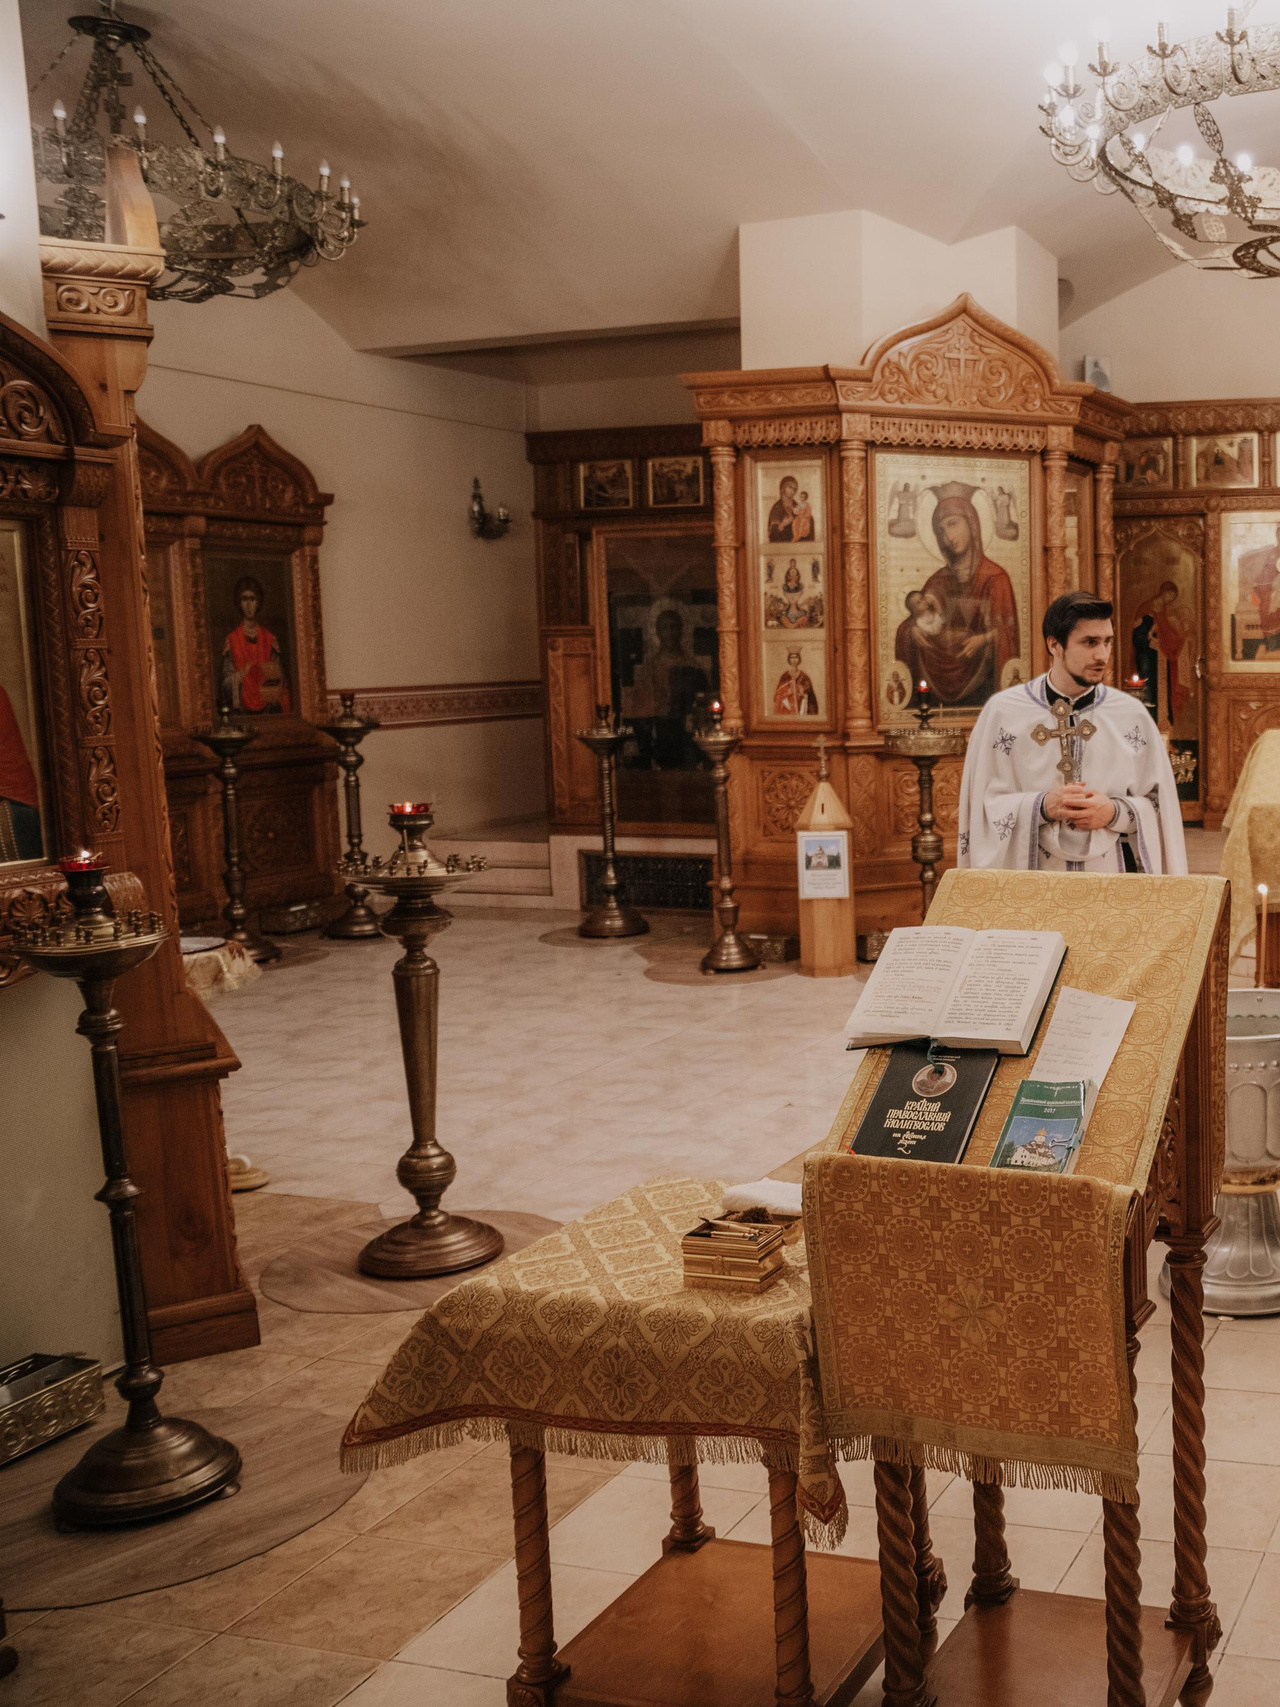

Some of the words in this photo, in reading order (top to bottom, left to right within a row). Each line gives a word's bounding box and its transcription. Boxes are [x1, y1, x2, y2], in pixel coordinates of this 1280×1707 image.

[904, 1098, 941, 1112] КРАТКИЙ
[886, 1109, 952, 1122] ПРАВОСЛАВНЫЙ
[883, 1118, 946, 1132] МОЛИТВОСЛОВ
